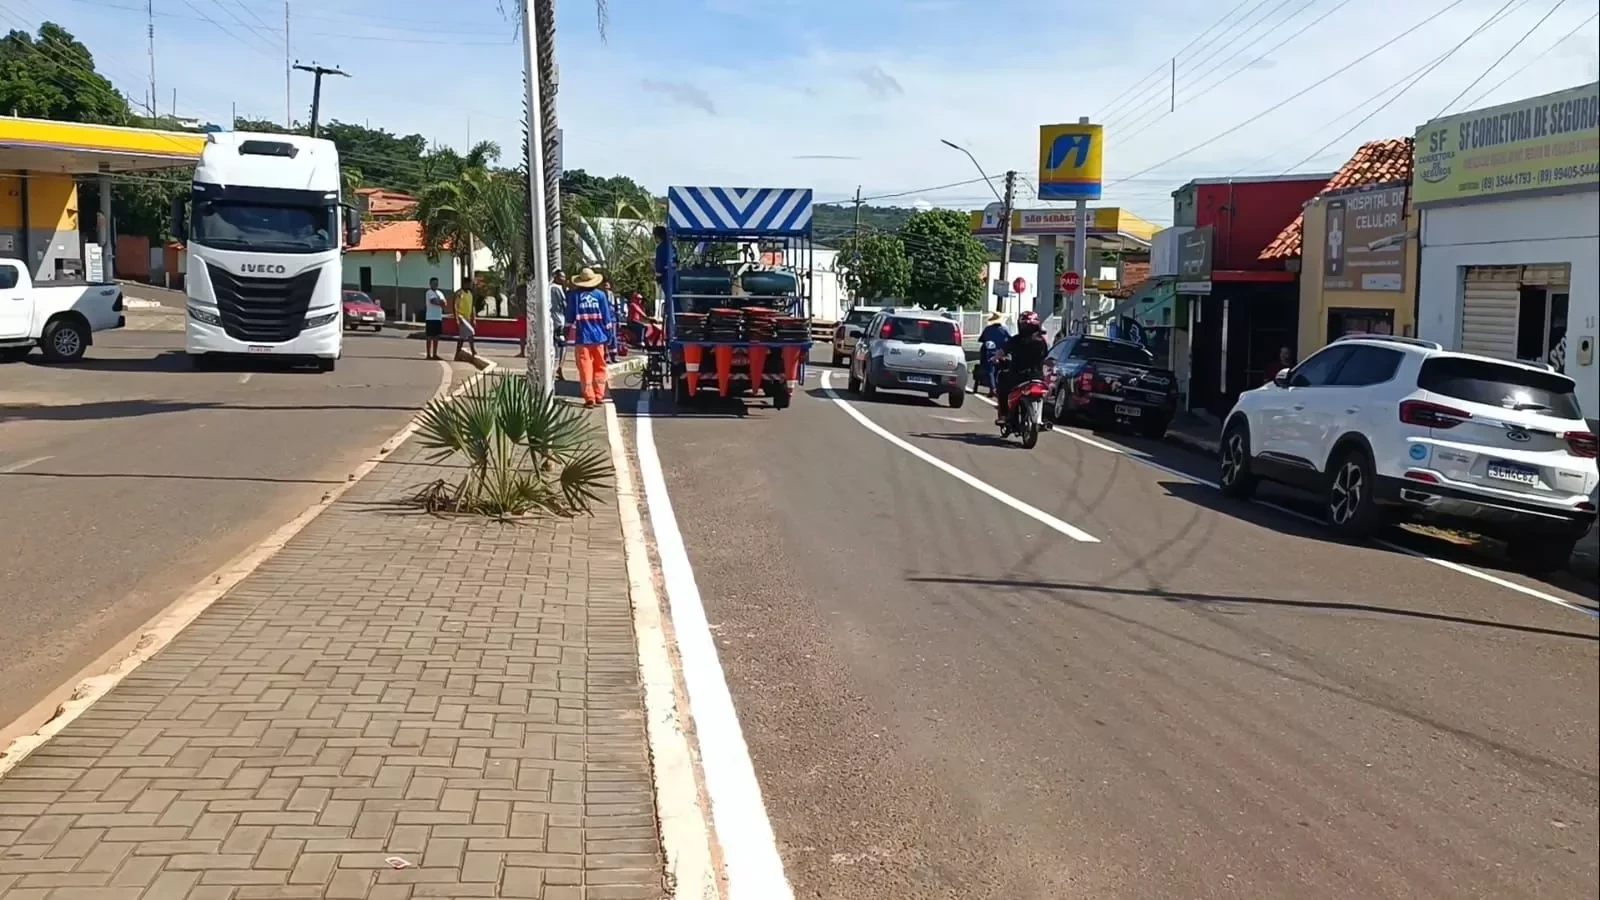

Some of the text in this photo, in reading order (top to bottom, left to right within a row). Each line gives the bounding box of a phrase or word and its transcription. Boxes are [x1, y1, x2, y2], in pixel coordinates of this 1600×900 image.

[1459, 95, 1599, 151] SF CORRETORA DE SEGURO
[1430, 129, 1448, 152] SF
[1347, 193, 1388, 212] HOSPITAL
[1356, 213, 1397, 228] CELULAR
[241, 264, 285, 273] IVECO
